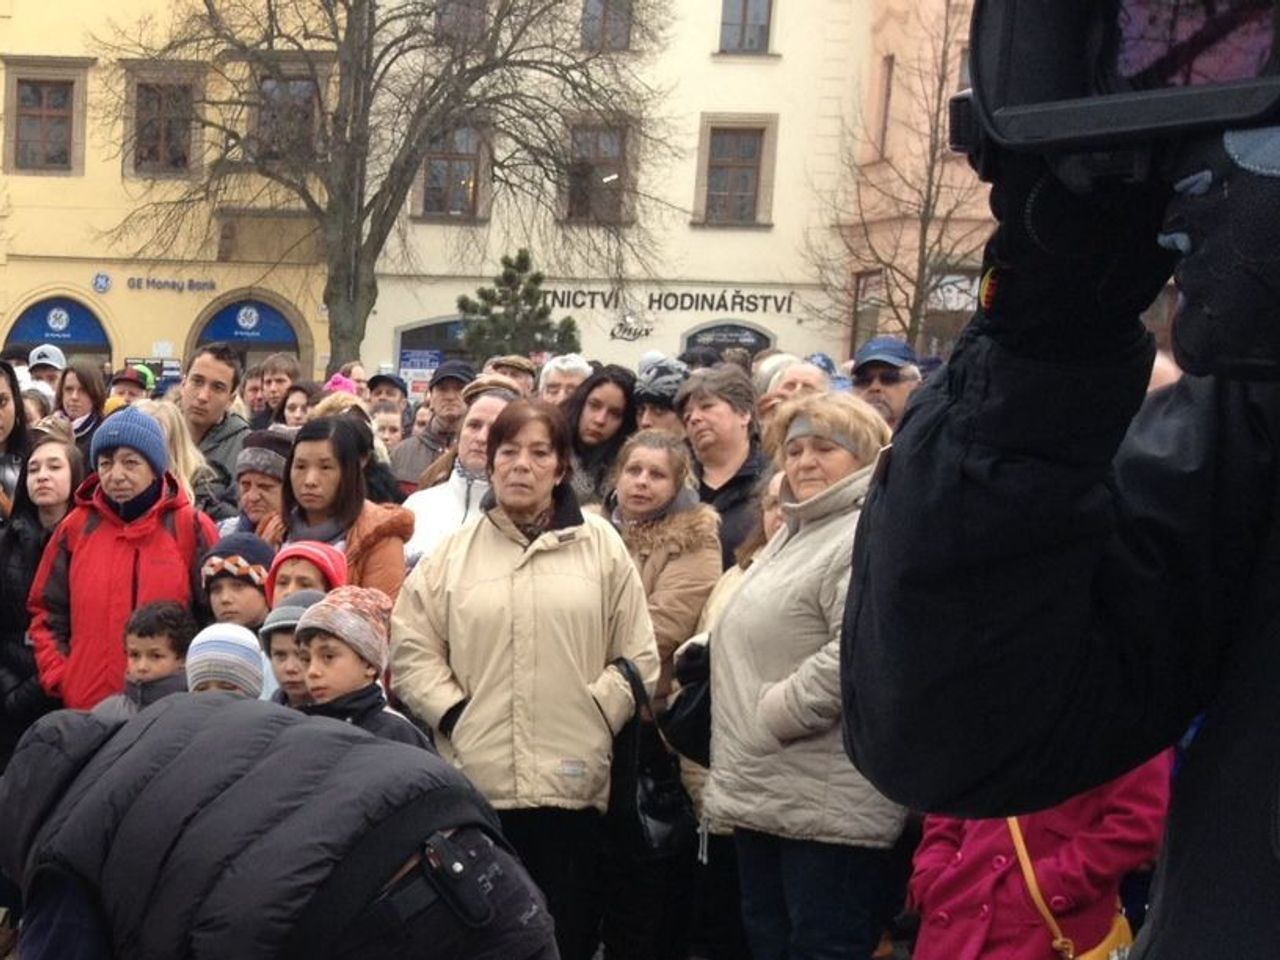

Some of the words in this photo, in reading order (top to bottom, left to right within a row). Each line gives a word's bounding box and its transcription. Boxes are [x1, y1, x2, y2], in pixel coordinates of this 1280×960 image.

[127, 277, 142, 289] GE
[146, 278, 184, 293] Money
[188, 278, 216, 291] Bank
[648, 290, 794, 314] HODINÁŘSTVÍ
